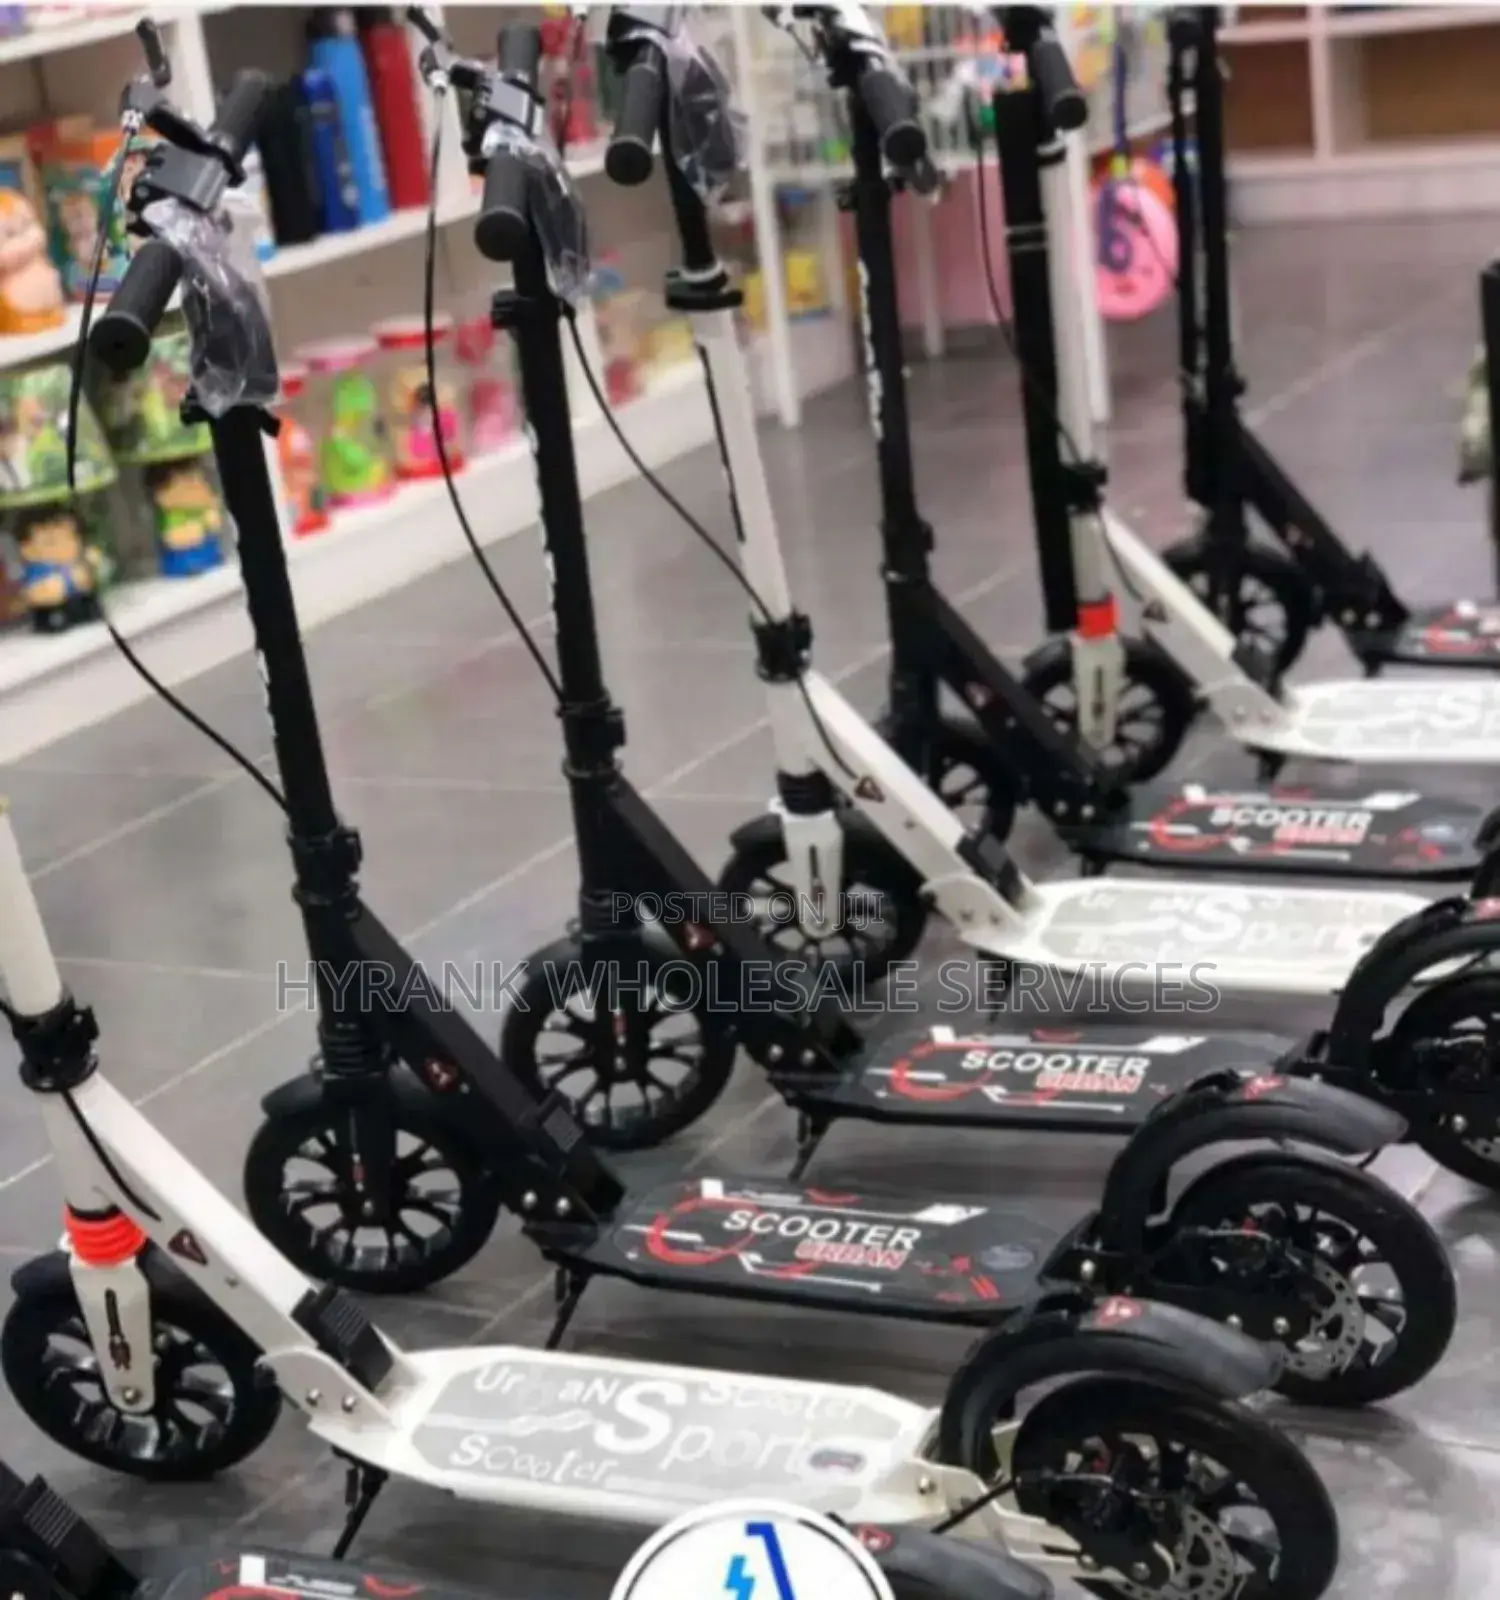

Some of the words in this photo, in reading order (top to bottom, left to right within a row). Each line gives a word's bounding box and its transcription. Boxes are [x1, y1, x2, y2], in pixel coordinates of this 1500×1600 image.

[1209, 806, 1373, 830] SCOOTER
[960, 1048, 1152, 1077] SCOOTER
[722, 1208, 922, 1250] SCOOTER
